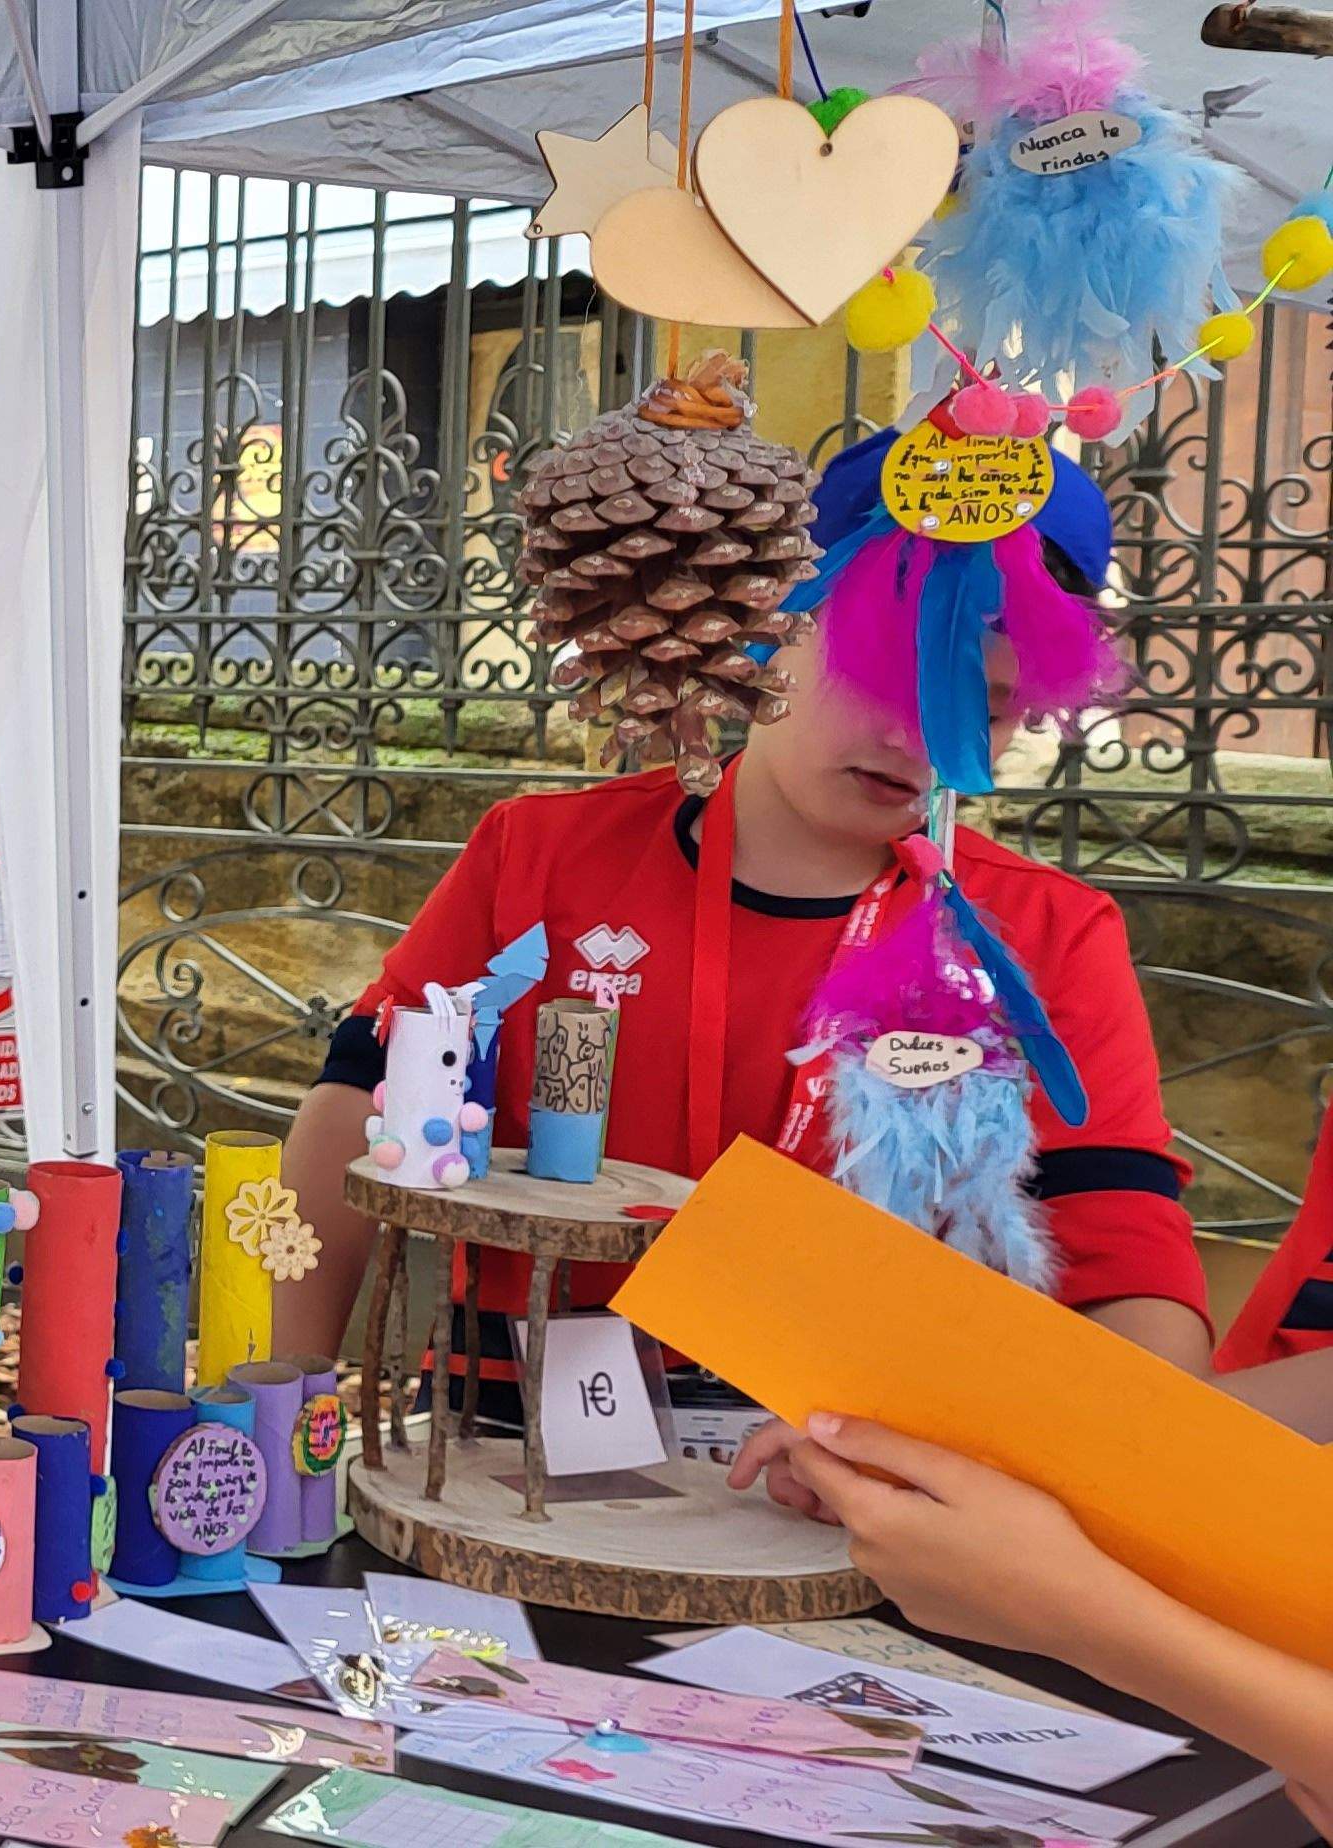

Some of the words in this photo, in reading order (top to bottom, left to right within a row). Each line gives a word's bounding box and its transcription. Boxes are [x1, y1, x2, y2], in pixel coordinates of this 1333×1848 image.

[1019, 127, 1087, 155] Nunca
[1041, 150, 1110, 172] rindas
[945, 500, 1014, 525] AÑOS
[889, 1035, 944, 1052] Dulces
